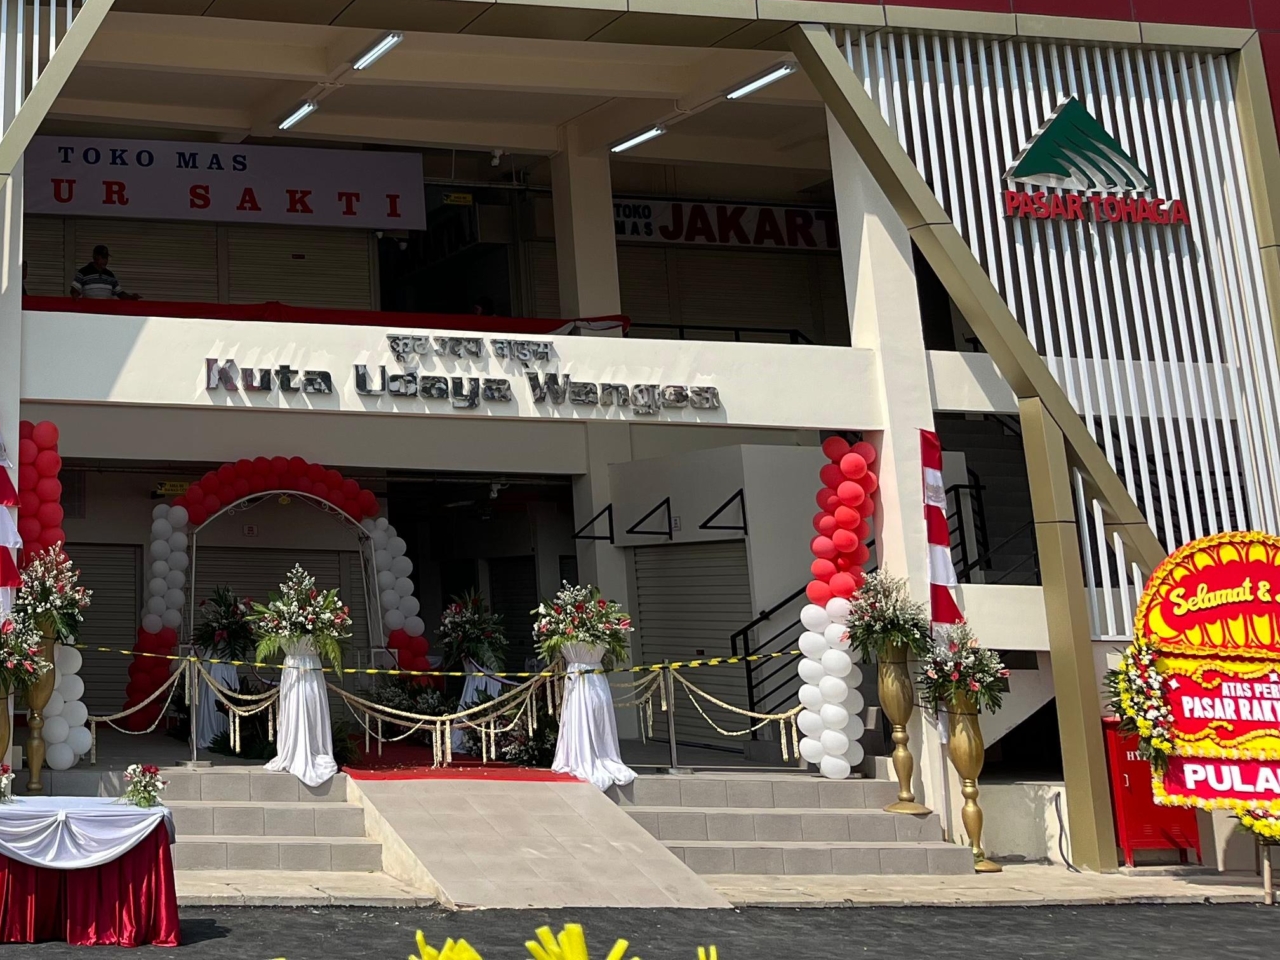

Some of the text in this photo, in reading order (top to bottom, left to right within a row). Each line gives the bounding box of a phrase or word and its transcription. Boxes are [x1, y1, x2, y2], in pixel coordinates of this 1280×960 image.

[58, 146, 248, 172] TOKO MAS
[189, 184, 402, 218] SAKTI
[613, 203, 651, 220] TOKO
[1004, 191, 1190, 225] PASAR TOHAGA
[205, 358, 719, 415] Kuta Udaya Wangsa
[1169, 577, 1272, 616] Selamat &
[1222, 682, 1252, 697] ATAS
[1181, 695, 1238, 720] PASAR
[1184, 764, 1280, 793] PULA
